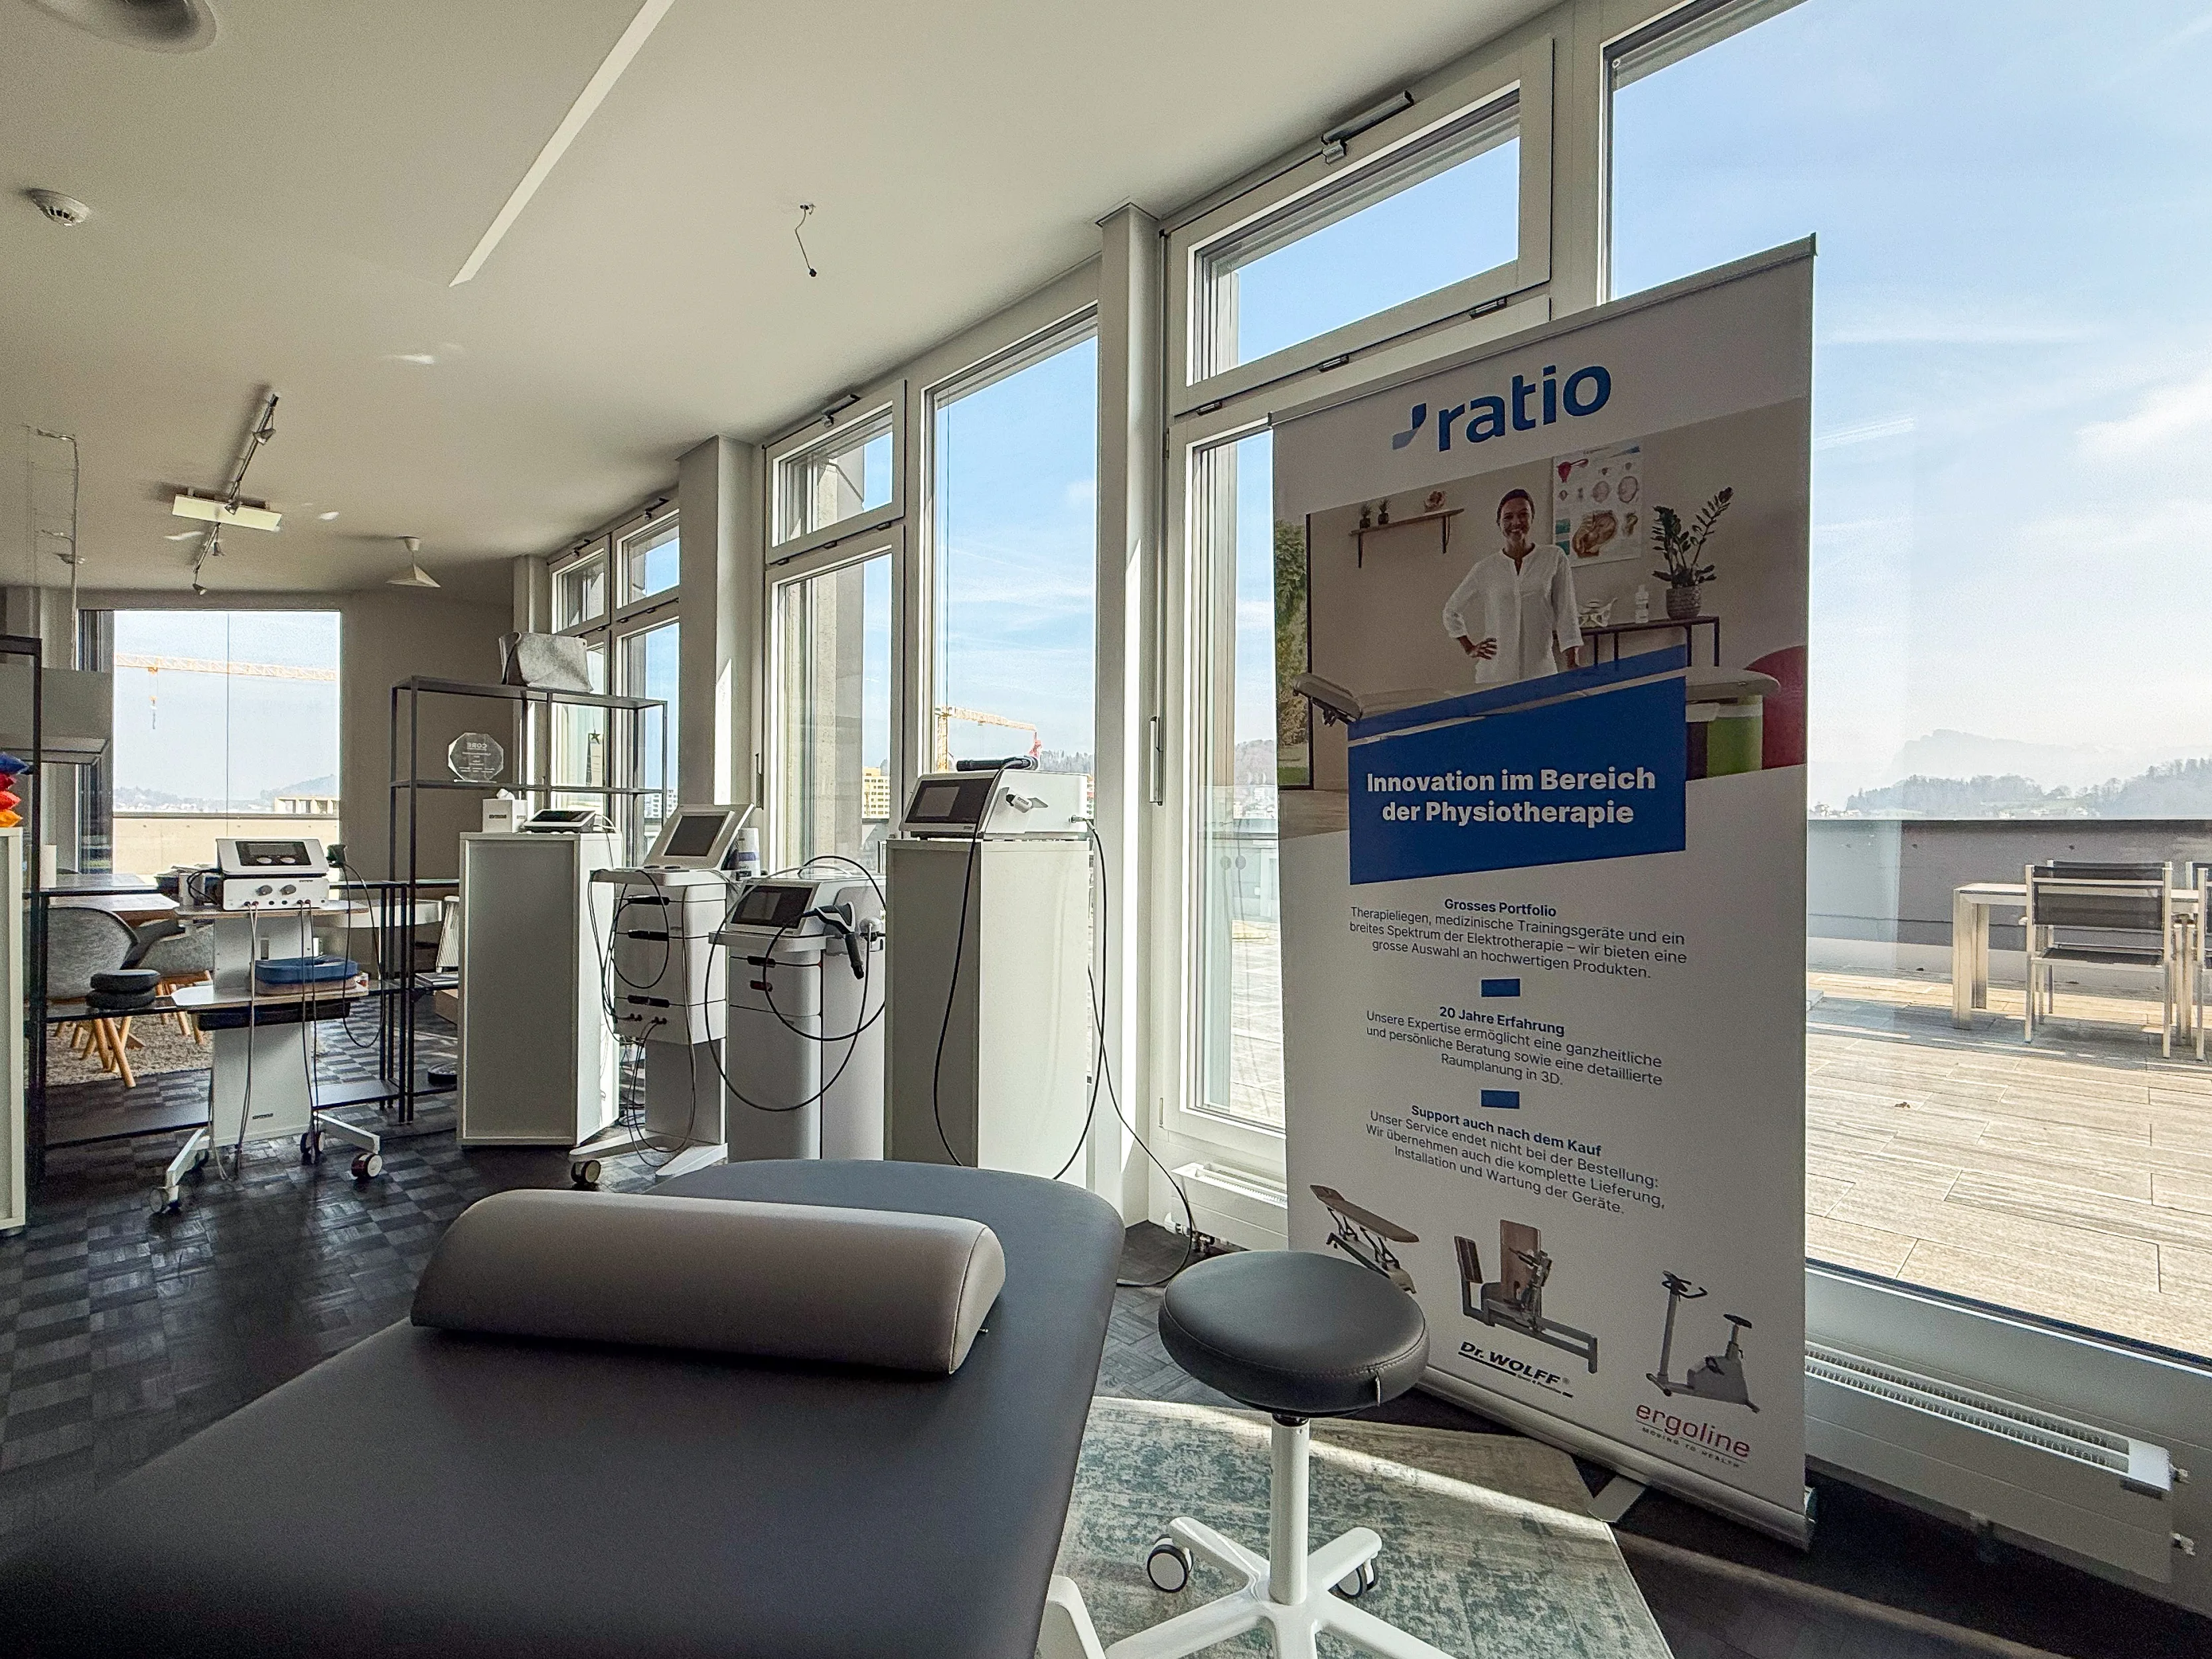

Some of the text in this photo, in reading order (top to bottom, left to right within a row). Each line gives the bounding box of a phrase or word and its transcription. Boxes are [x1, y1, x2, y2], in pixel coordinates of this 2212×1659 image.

[1438, 365, 1611, 452] ratio
[1367, 766, 1657, 792] Innovation im Bereich
[1382, 800, 1635, 828] der Physiotherapie
[1351, 906, 1684, 945] Therapieliegen, medizinische Trainingsgeräte und ein
[1445, 899, 1556, 917] Grosses Portfolio
[1349, 922, 1384, 934] breites
[1387, 925, 1440, 940] Spektrum
[1444, 930, 1464, 942] der
[1467, 932, 1564, 952] Elektrotherapie
[1579, 944, 1600, 956] wir
[1604, 945, 1649, 960] bieten
[1655, 951, 1687, 964] eine
[1372, 941, 1651, 978] grosse Auswahl an hochwertigen Produkten.
[1366, 1010, 1662, 1067] Unsere Expertise ermöglicht eine ganzheitliche
[1439, 1007, 1564, 1037] 20 Jahre Erfahrung
[1366, 1027, 1662, 1085] und persönliche Beratung sowie eine detaillierte
[1441, 1053, 1563, 1085] Raumplanung in 3D.
[1370, 1110, 1659, 1189] Unser Service endet nicht bei der Bestellung:
[1412, 1105, 1602, 1157] Support auch nach dem Kauf
[1366, 1123, 1665, 1209] Wir übernehmen auch die komplette Lieferung,
[1394, 1145, 1625, 1214] Installation und Wartung der Geräte.
[1461, 1341, 1484, 1358] Dr.
[1636, 1404, 1749, 1457] ergoline
